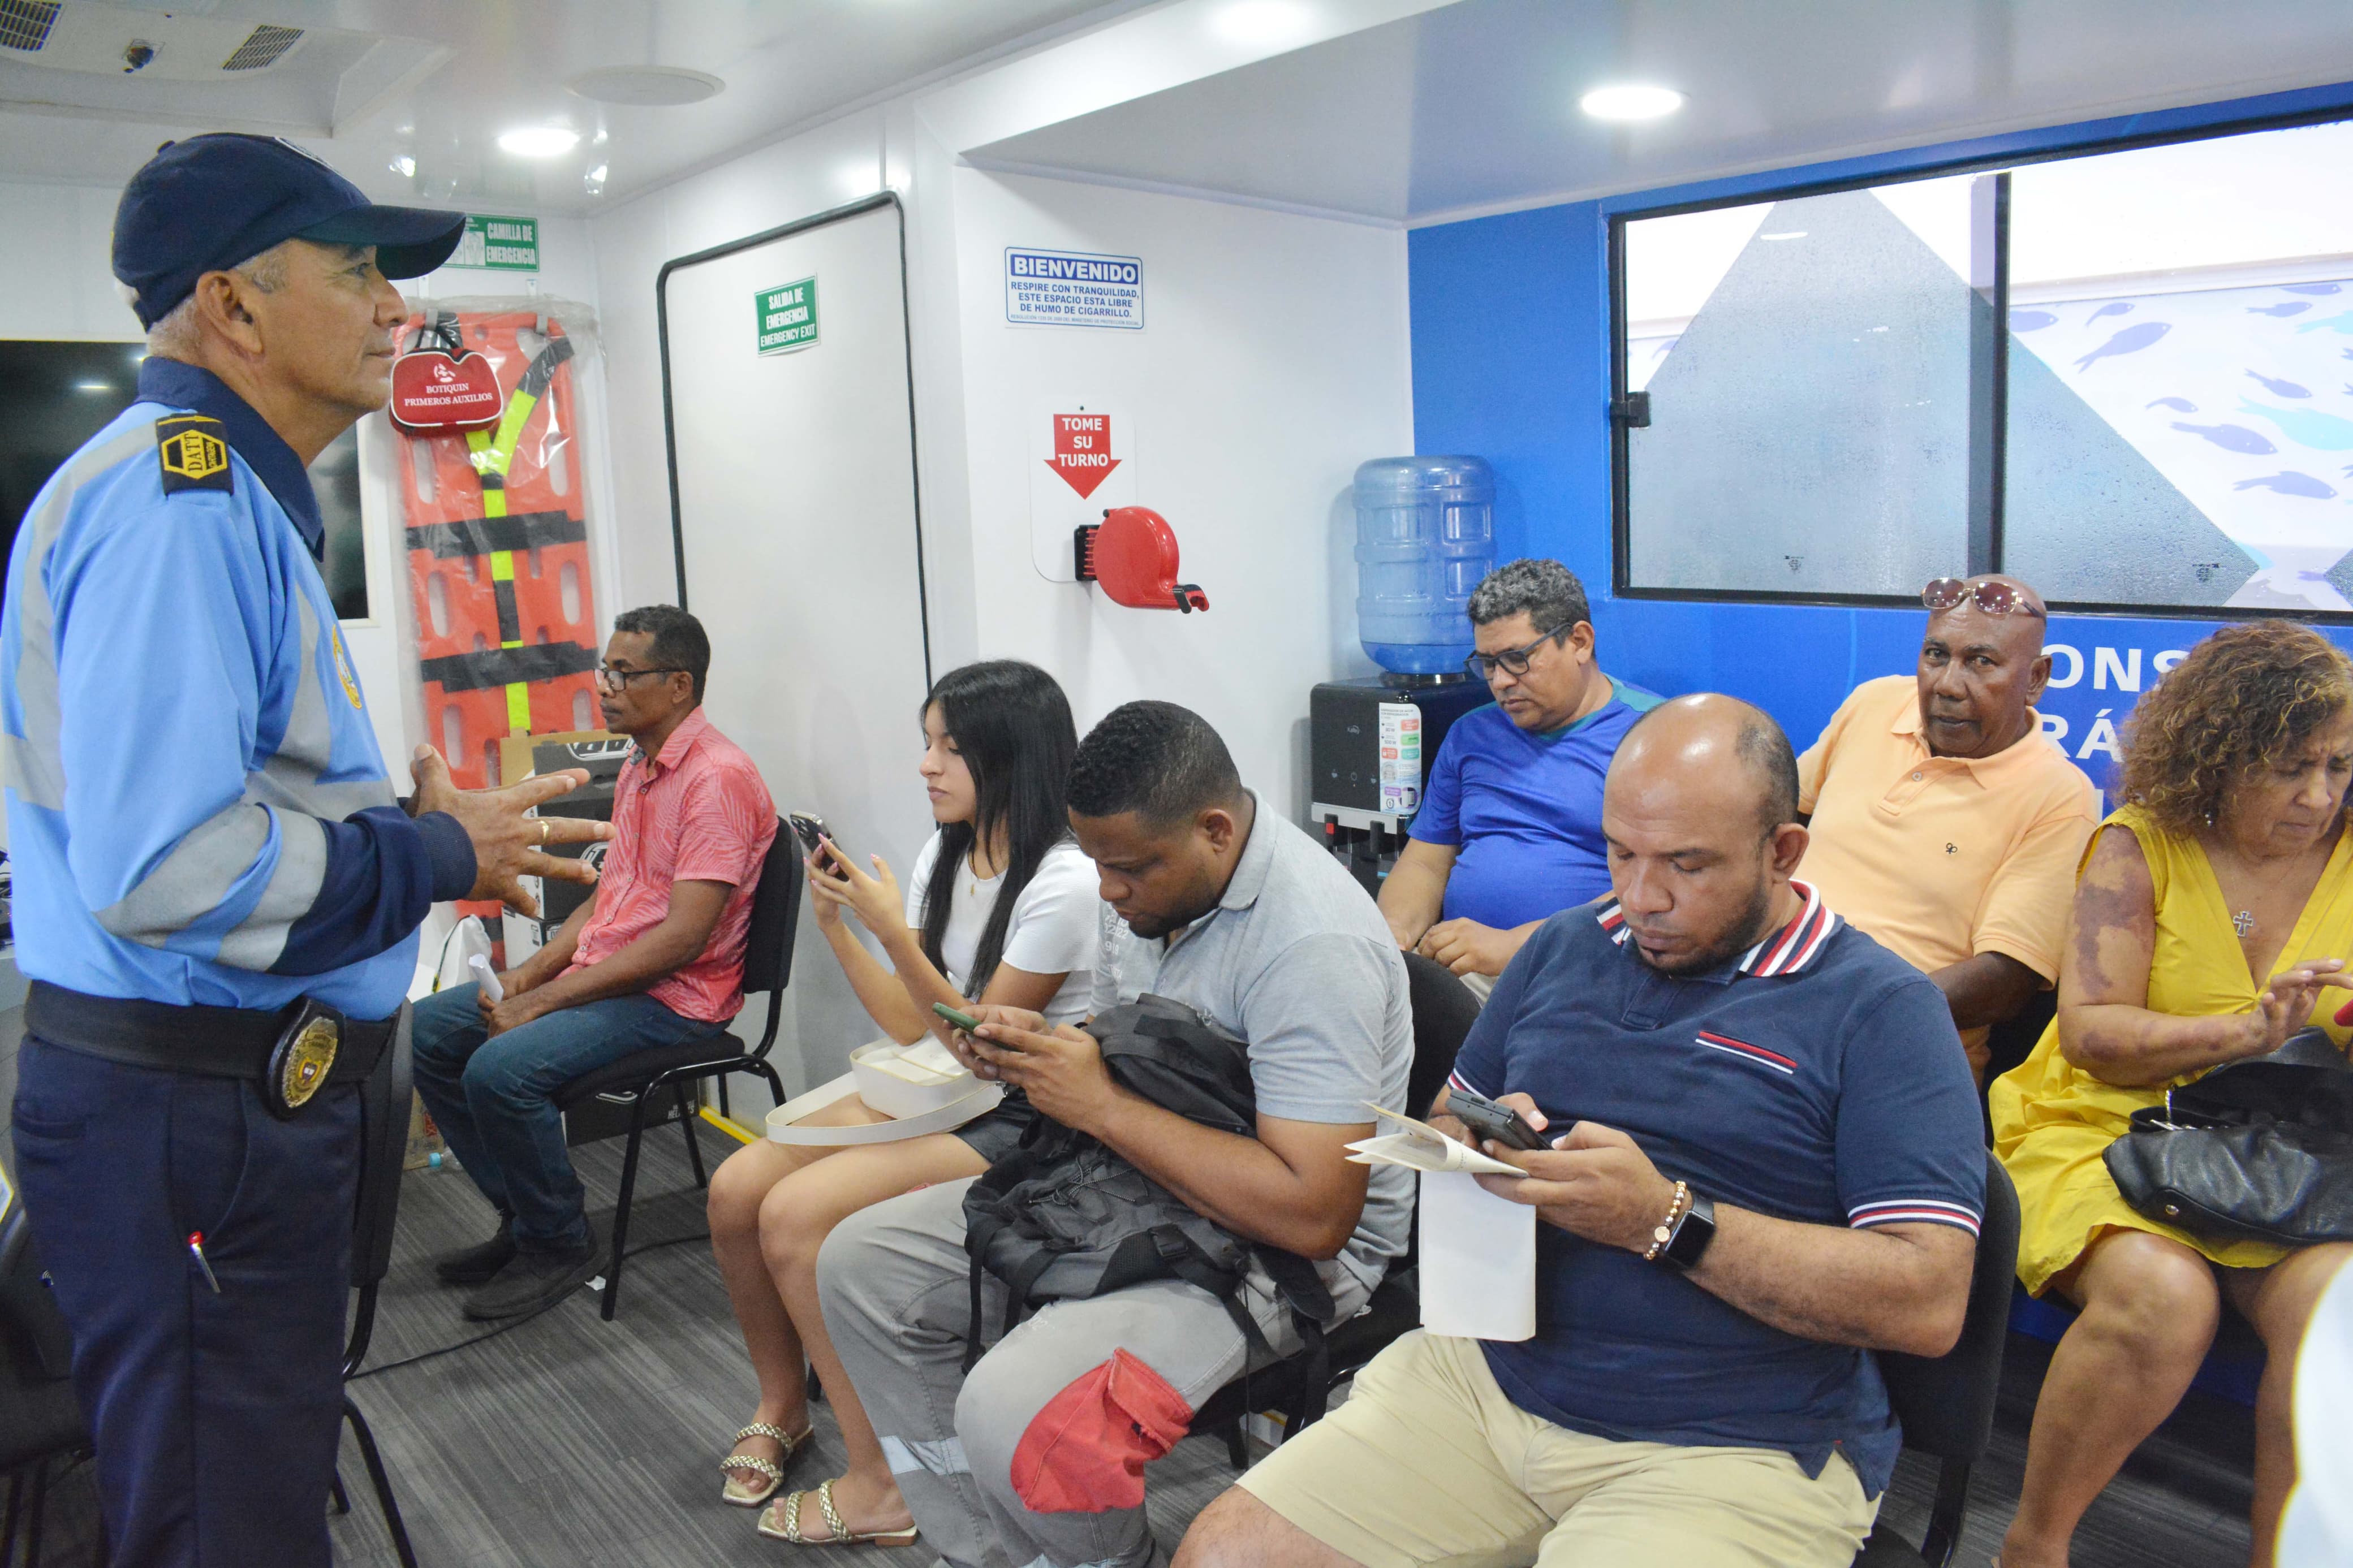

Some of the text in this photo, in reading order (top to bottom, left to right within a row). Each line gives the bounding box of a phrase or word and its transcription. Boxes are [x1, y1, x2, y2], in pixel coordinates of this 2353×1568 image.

[487, 222, 533, 241] CAMILLA DE
[486, 245, 536, 265] EMERGENCIA
[1014, 256, 1136, 283] BIENVENIDO
[768, 287, 804, 310] SALIDA DE
[1011, 282, 1139, 299] RESPIRE CON TRANQUILIDAD,
[1019, 292, 1133, 308] ESTE ESPACIO ESTA LIBRE
[766, 305, 809, 330] EMERGENCIA
[1020, 303, 1132, 317] DE HUMO DE CIGARRILLO.
[760, 323, 816, 347] EMERGENCY EXIT
[426, 383, 469, 394] BOTIQUIN
[404, 392, 493, 407] PRIMEROS AUXILIOS
[1062, 417, 1102, 431] TOME
[1073, 435, 1092, 448] SU
[184, 433, 204, 472] DATT
[1058, 453, 1109, 466] TURNO
